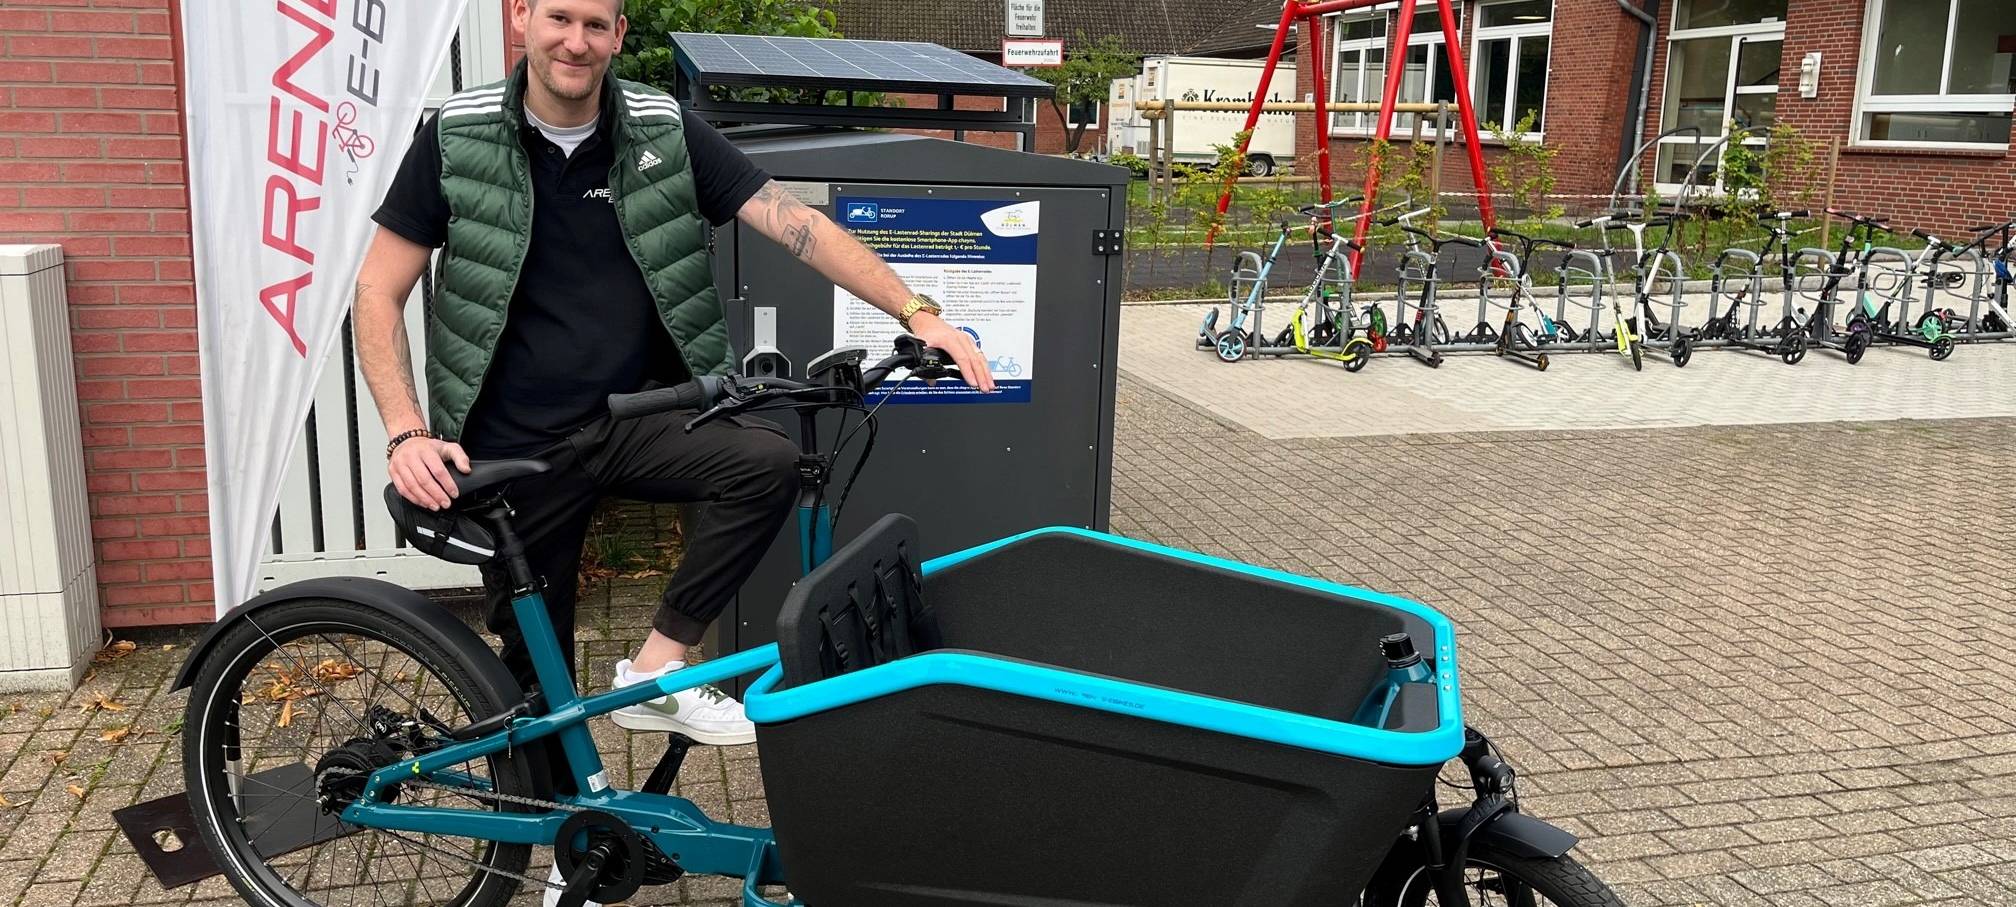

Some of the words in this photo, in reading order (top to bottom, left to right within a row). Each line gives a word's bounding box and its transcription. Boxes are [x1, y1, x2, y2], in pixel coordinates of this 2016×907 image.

[1014, 12, 1037, 21] Feuerwehr
[1007, 48, 1059, 56] Feuerwehrzufahrt
[637, 157, 663, 172] adidas
[259, 0, 338, 359] AREN
[857, 228, 879, 236] Nutzung
[889, 229, 940, 237] E-Lastenrad-Sharings
